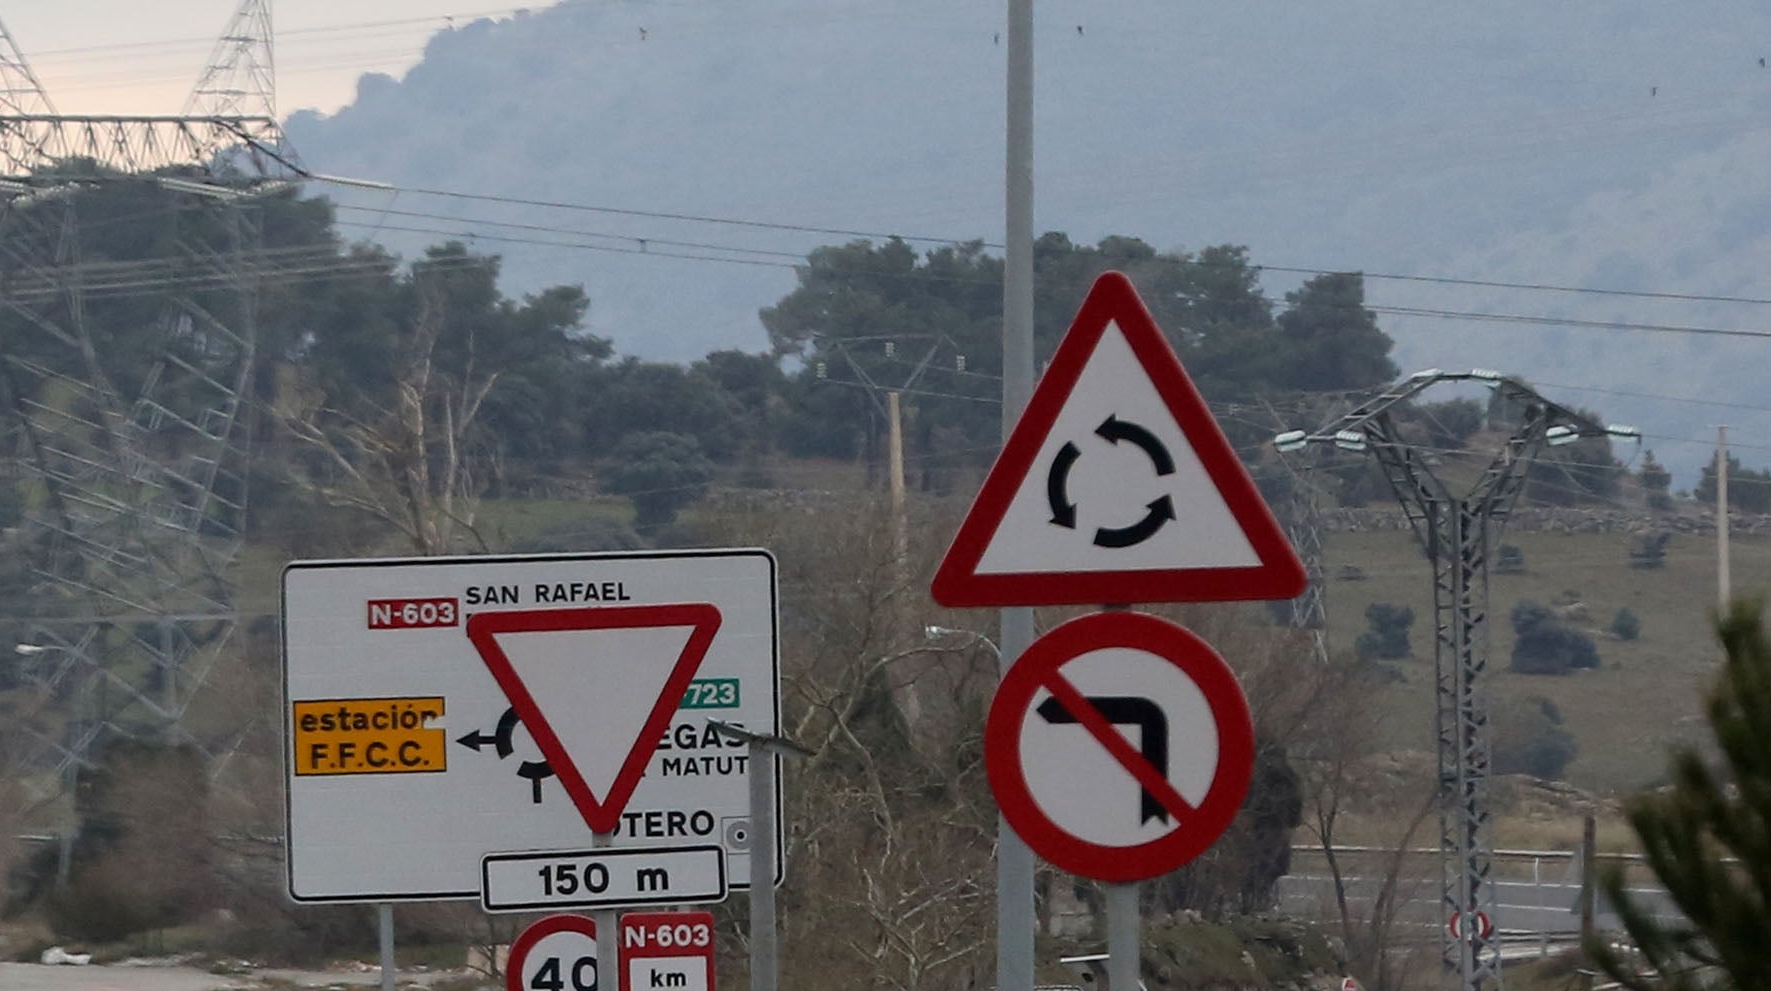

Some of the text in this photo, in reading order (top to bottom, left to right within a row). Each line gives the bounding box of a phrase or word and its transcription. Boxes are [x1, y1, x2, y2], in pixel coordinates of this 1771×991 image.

[466, 582, 631, 605] SAN RAFAEL
[371, 602, 454, 625] N-603
[311, 740, 431, 769] F.F.C.C.
[662, 755, 749, 776] MATUT
[613, 810, 715, 838] TERO
[538, 862, 669, 896] 150 m
[625, 923, 710, 948] N-603
[650, 968, 687, 988] km
